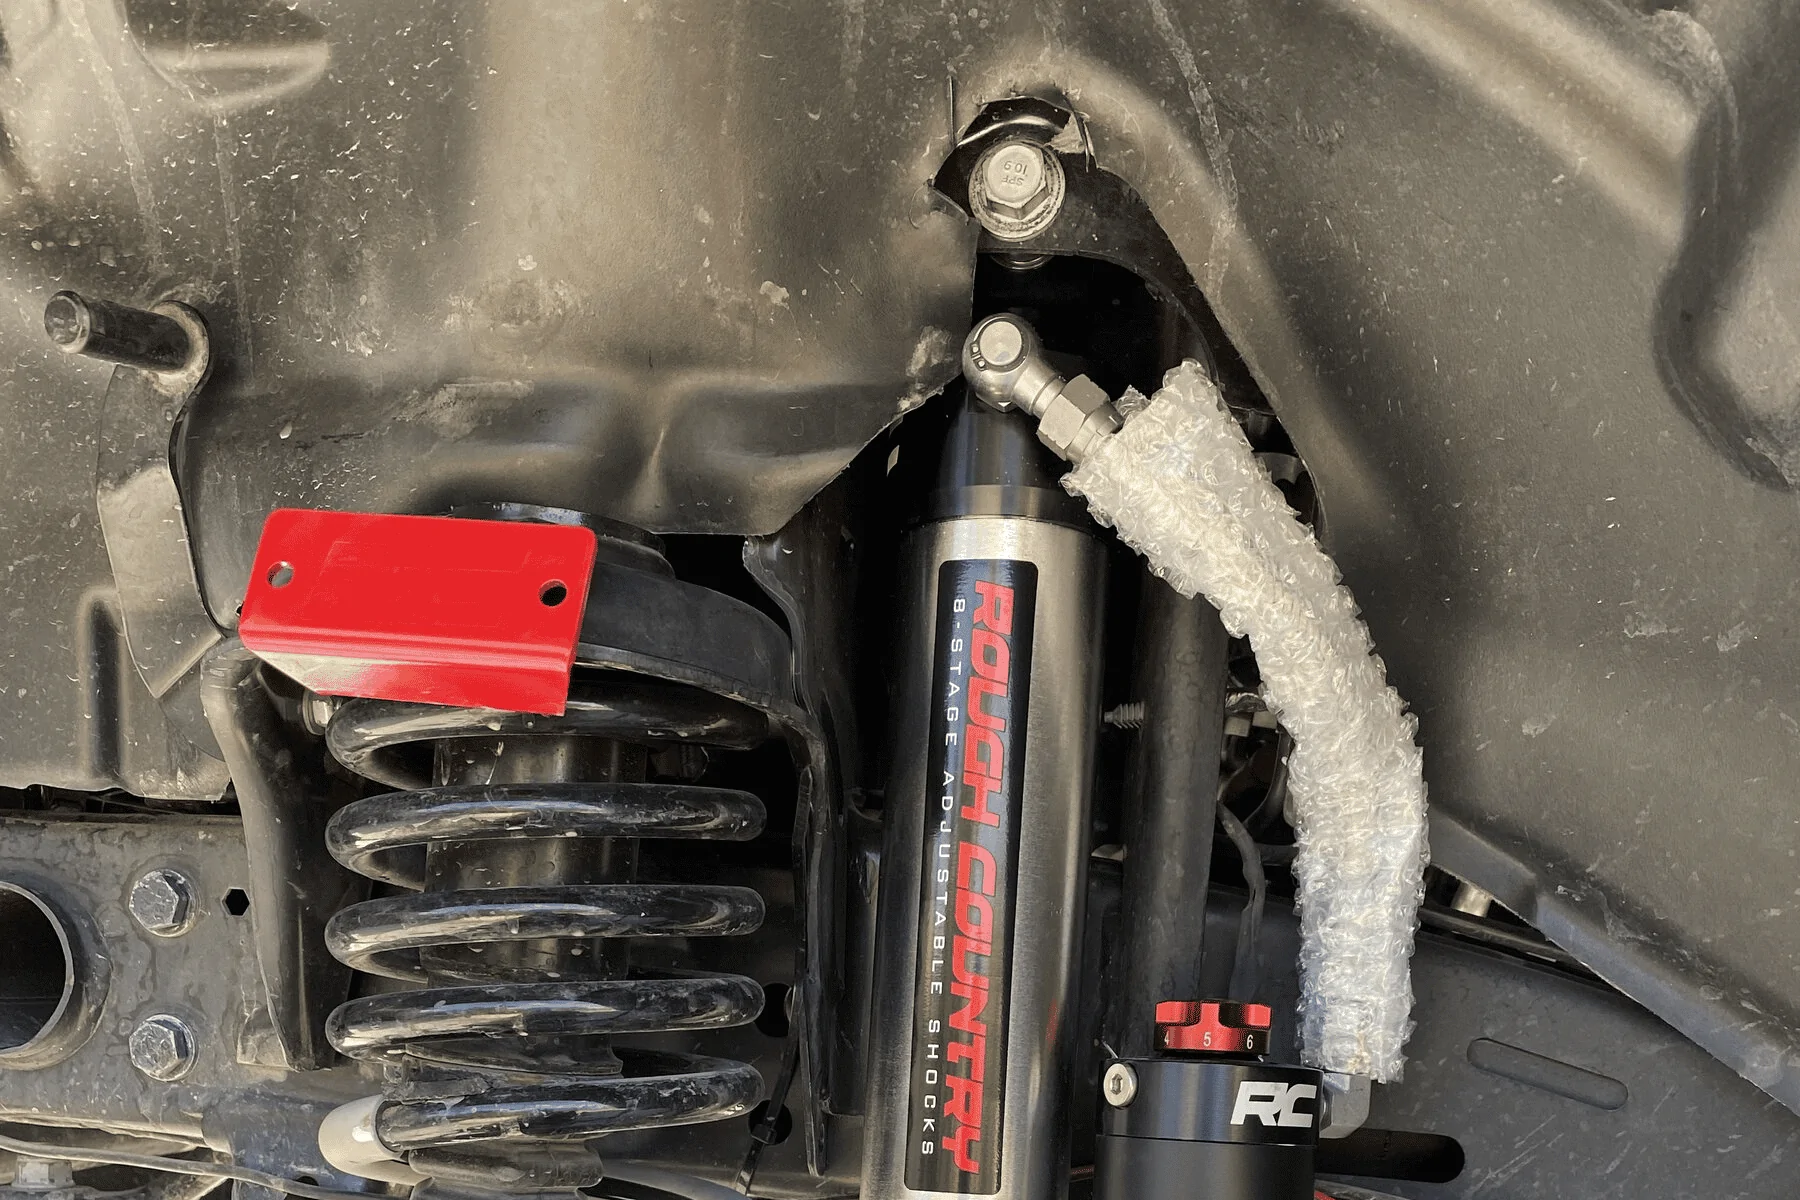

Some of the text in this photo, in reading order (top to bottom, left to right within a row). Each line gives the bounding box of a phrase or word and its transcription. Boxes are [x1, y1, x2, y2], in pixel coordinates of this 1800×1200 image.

[921, 597, 966, 1156] 8-STAGE ADJUSTABLE SHOCKS
[940, 580, 1014, 1175] ROUGH COUNTRY
[1203, 1031, 1212, 1047] 5
[1246, 1034, 1254, 1050] 6
[1230, 1080, 1317, 1128] RC
